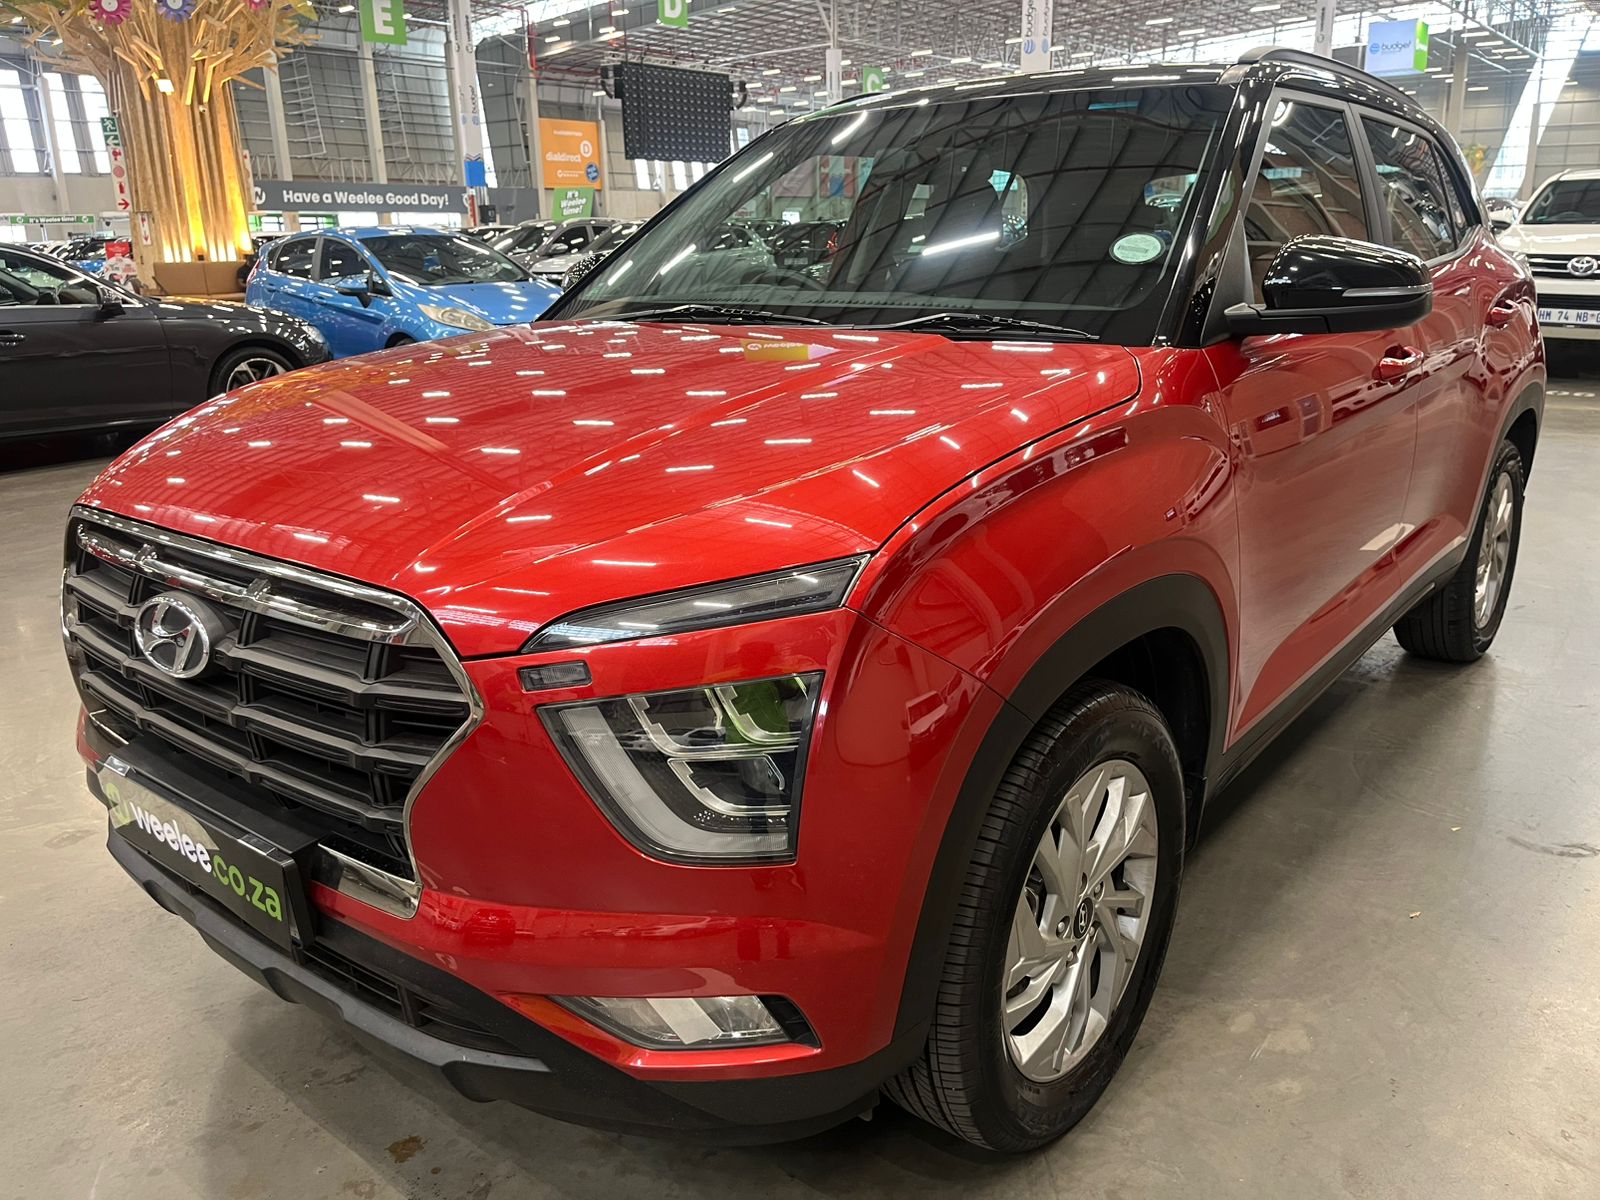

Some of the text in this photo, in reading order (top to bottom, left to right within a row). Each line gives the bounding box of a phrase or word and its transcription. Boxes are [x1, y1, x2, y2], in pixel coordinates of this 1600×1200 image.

[372, 0, 394, 35] E
[283, 190, 449, 209] Have a Weelee Good Day!
[1558, 311, 1569, 321] 74
[1576, 312, 1589, 322] NB
